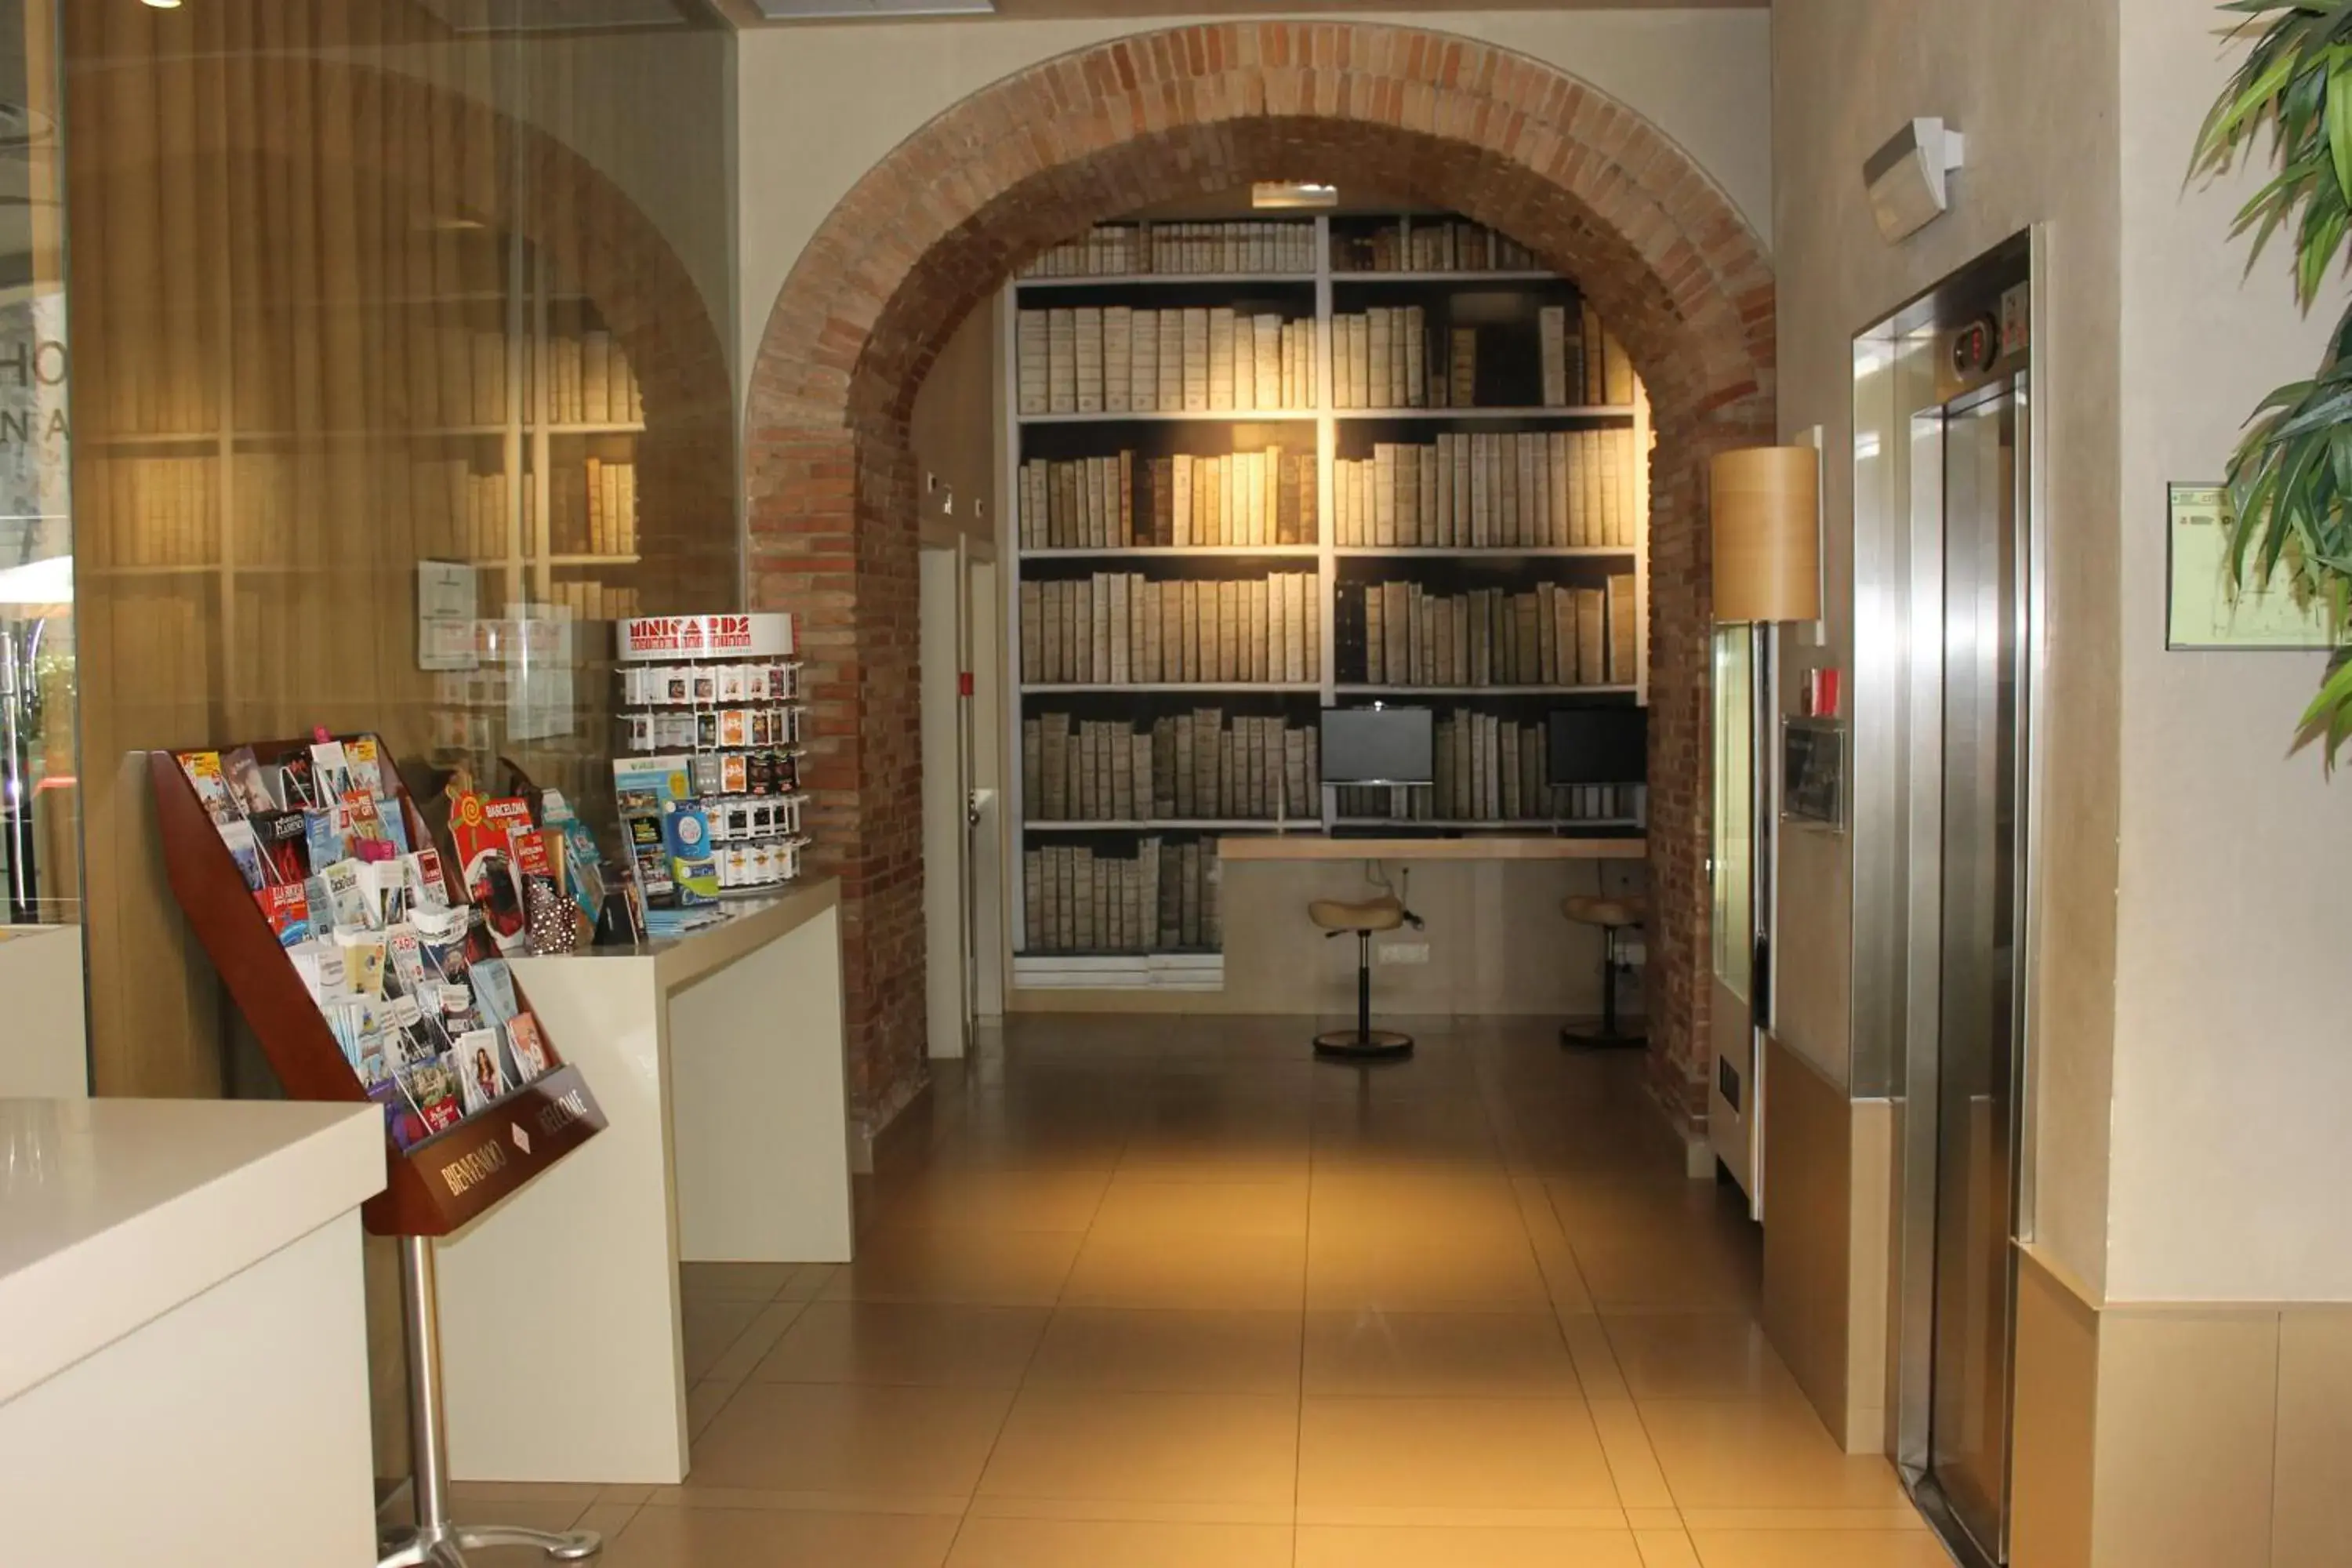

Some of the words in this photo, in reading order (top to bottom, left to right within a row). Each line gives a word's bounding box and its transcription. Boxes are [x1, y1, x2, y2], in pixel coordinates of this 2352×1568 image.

[630, 616, 750, 637] MINICARDS
[485, 802, 528, 818] BARCELONA
[441, 1138, 506, 1197] BIENVENIDO
